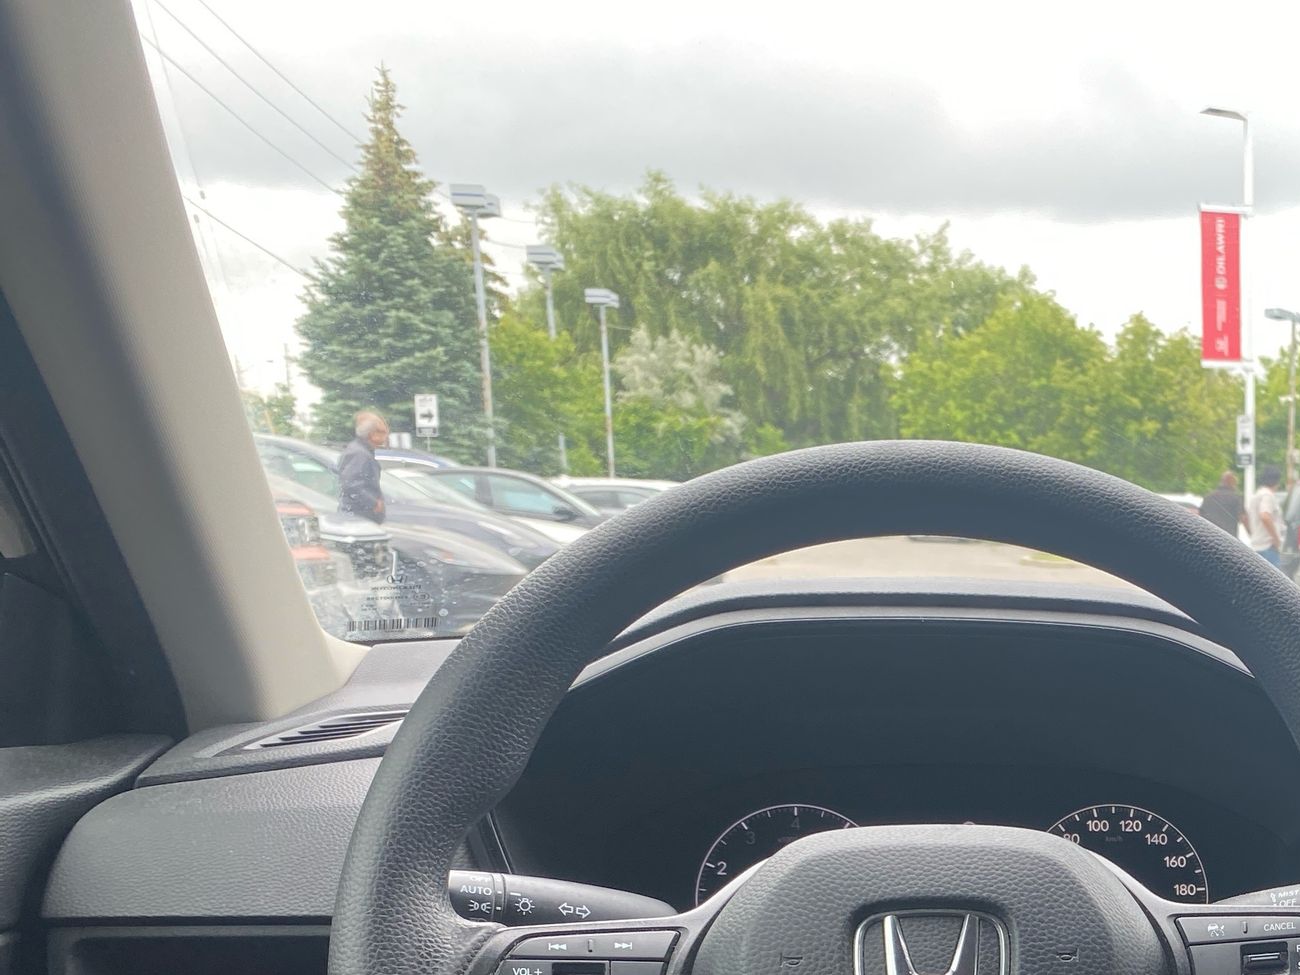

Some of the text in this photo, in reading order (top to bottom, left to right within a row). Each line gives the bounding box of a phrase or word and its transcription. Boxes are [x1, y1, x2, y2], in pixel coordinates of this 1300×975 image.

[1086, 820, 1109, 832] 100
[1119, 820, 1142, 832] 120
[1145, 833, 1168, 845] 140
[1164, 856, 1187, 868] 160
[716, 861, 728, 876] 2
[460, 884, 493, 896] AUTO
[1174, 884, 1197, 896] 180
[1279, 898, 1296, 907] OFF
[1263, 921, 1297, 932] CANCEL
